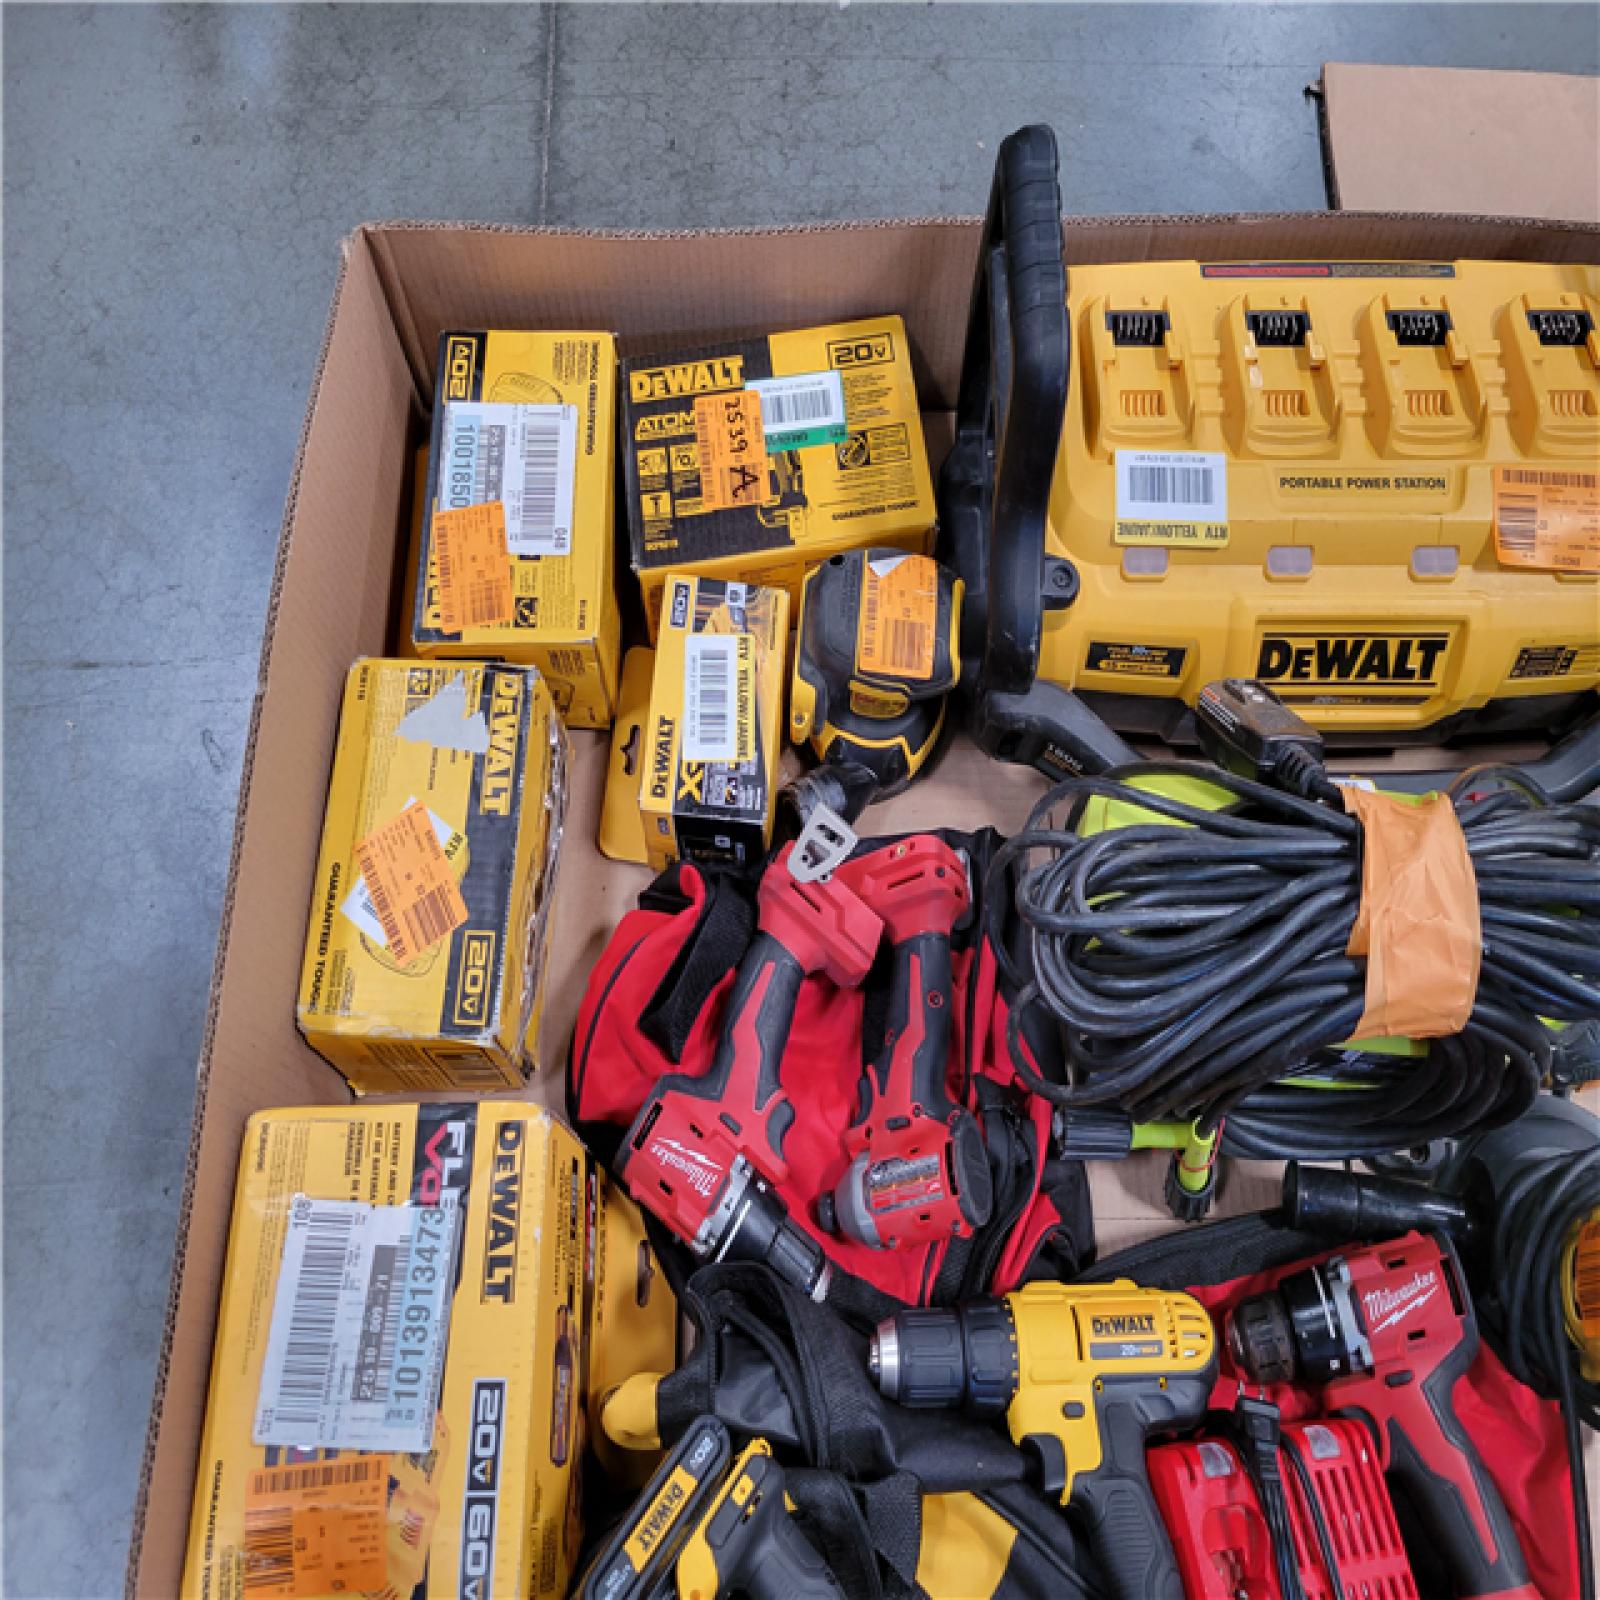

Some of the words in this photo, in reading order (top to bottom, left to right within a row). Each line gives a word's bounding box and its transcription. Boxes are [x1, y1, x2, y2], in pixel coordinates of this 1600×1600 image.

[630, 356, 743, 403] DEWALT
[834, 343, 886, 365] 20V
[638, 410, 697, 434] ATOM
[449, 424, 476, 508] 1001850
[1279, 477, 1343, 489] PORTABLE
[1347, 477, 1391, 489] POWER
[1395, 477, 1446, 489] STATION
[1117, 523, 1198, 538] YELLOW/JAUNE
[1205, 526, 1228, 540] RTV
[738, 637, 749, 660] RTV
[1257, 640, 1448, 680] DEWALT
[480, 673, 522, 816] DEWALT
[737, 669, 748, 758] YELLOW/JAUNE
[650, 715, 674, 798] DEWALT
[317, 862, 341, 956] GUARANTEED
[462, 938, 488, 1016] 20V
[390, 1122, 401, 1165] BATTERY
[420, 1123, 447, 1206] VO
[440, 1121, 466, 1209] FLE
[484, 1121, 522, 1305] DEWALT
[391, 1209, 445, 1405] 1013913473
[1092, 1315, 1155, 1336] DEWALT
[1364, 1269, 1437, 1322] Milwaukee
[472, 1390, 500, 1484] 20V
[206, 1459, 224, 1561] GUARANTEED
[637, 1481, 682, 1550] DEWALT
[464, 1505, 491, 1600] 60V
